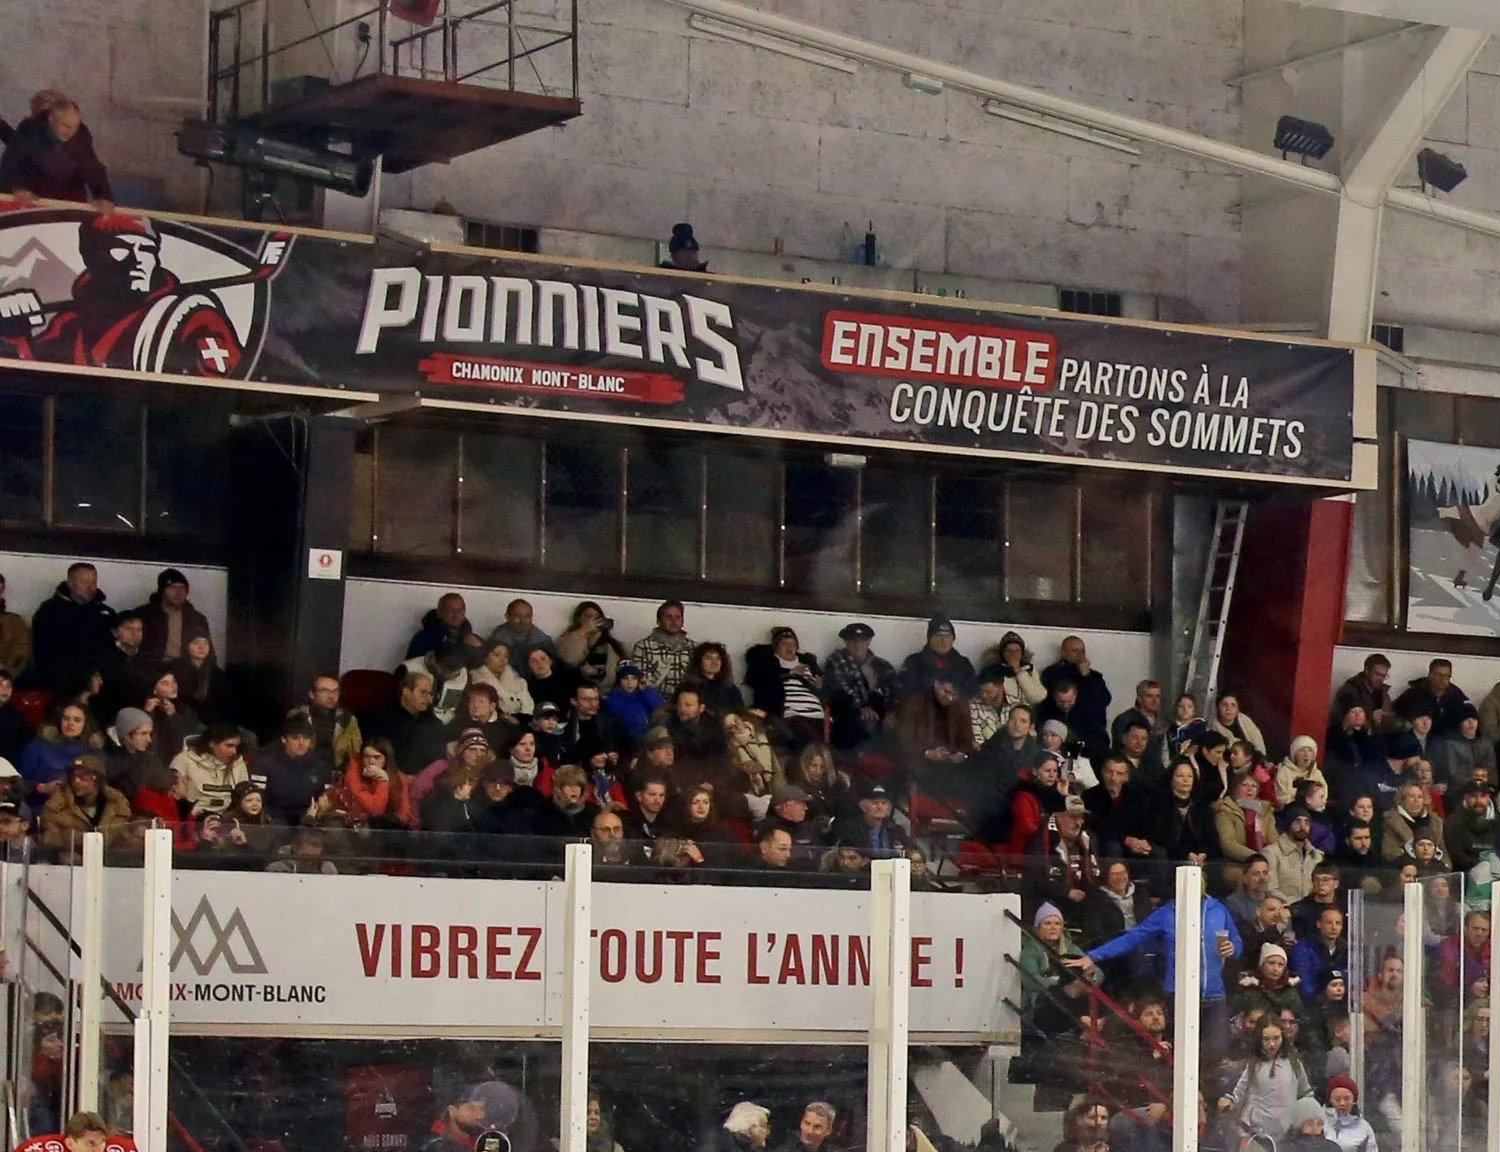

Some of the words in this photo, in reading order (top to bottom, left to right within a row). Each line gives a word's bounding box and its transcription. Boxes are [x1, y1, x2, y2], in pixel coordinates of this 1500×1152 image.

[355, 266, 744, 392] PIONNIERS
[830, 319, 1051, 385] ENSEMBLE
[1058, 356, 1186, 404] PARTONS
[1193, 365, 1211, 405] À
[1221, 376, 1249, 410] LA
[452, 361, 524, 384] CHAMONIX
[531, 369, 625, 393] MONT-BLANC
[890, 382, 1066, 439] CONQUÊTE
[1076, 401, 1136, 444] DES
[1150, 407, 1305, 459] SOMMETS
[355, 923, 543, 981] VIBREZ
[590, 928, 722, 984] OUTE
[747, 932, 932, 988] L'ANNE
[955, 938, 964, 989] !
